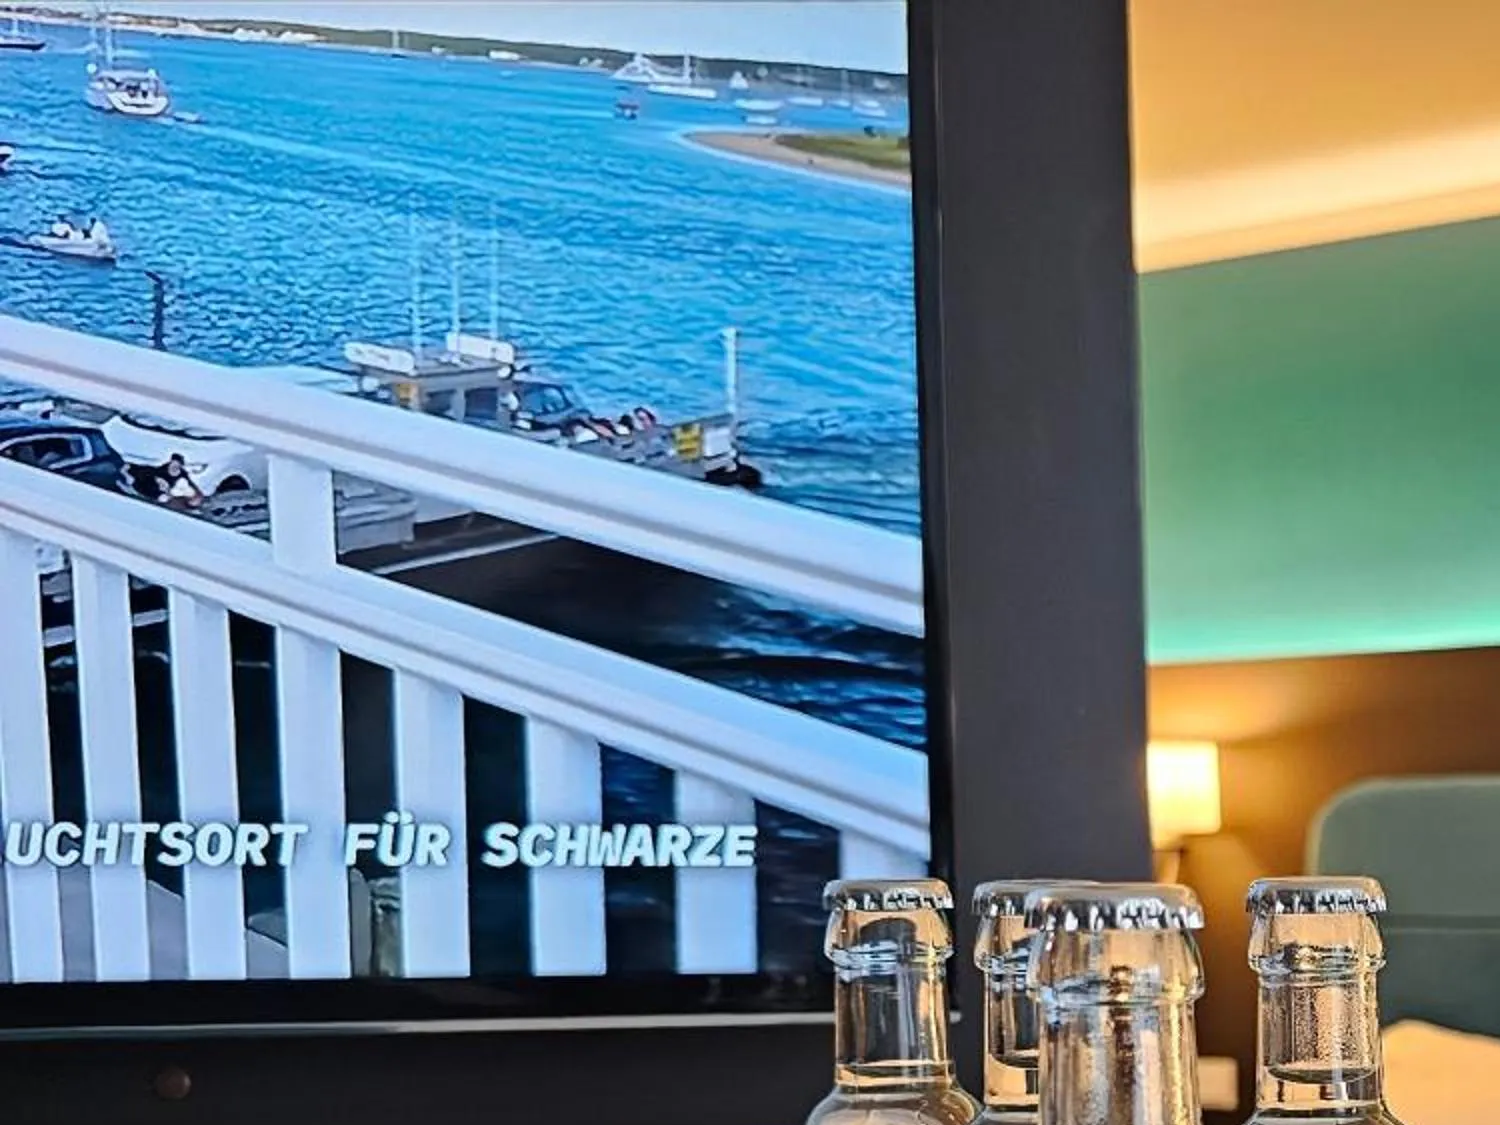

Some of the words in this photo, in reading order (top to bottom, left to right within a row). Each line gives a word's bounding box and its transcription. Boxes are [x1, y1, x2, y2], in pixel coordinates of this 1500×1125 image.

[2, 821, 308, 867] UCHTSORT
[345, 812, 450, 867] FÜR
[480, 822, 758, 867] SCHWARZE
